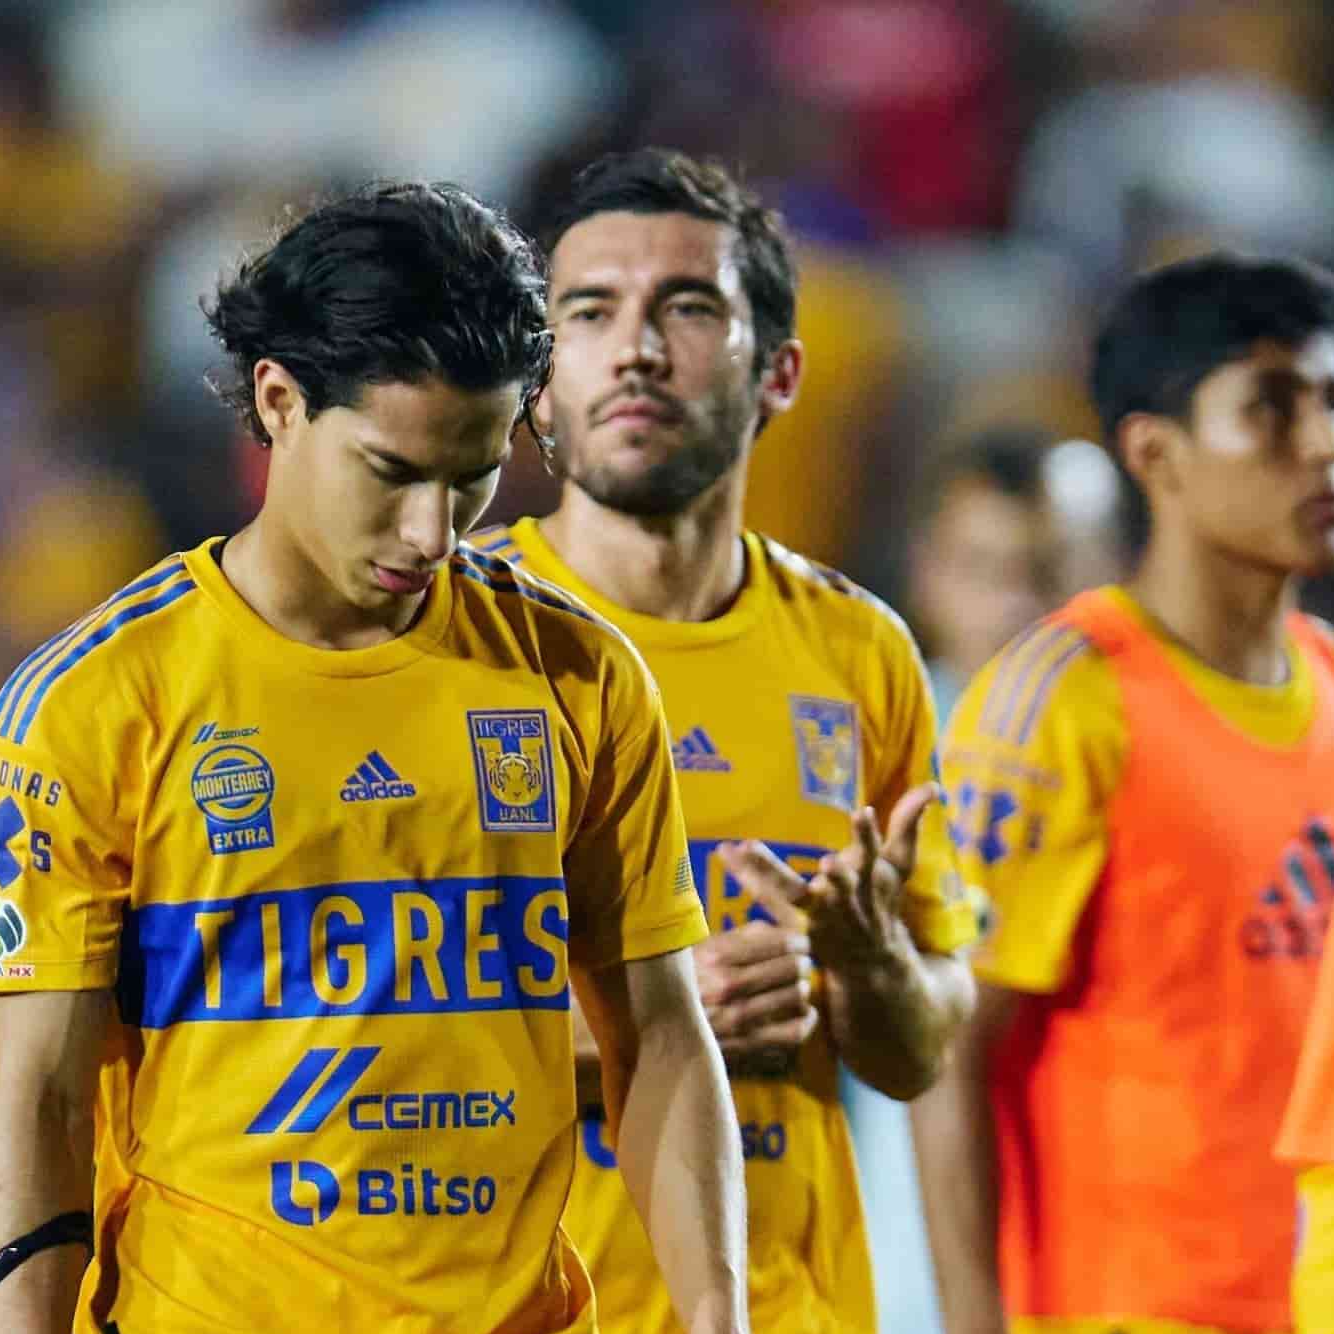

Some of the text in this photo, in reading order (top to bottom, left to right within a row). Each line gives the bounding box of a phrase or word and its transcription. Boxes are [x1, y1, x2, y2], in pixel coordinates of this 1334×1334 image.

[477, 719, 541, 737] TIGRES
[193, 769, 271, 801] MONTERREY
[340, 783, 417, 803] adidas
[499, 807, 537, 822] UANL
[211, 826, 269, 850] EXTRA
[194, 888, 569, 1010] TIGRES
[348, 1090, 516, 1131] CEMEX
[357, 1163, 496, 1216] Bitso
